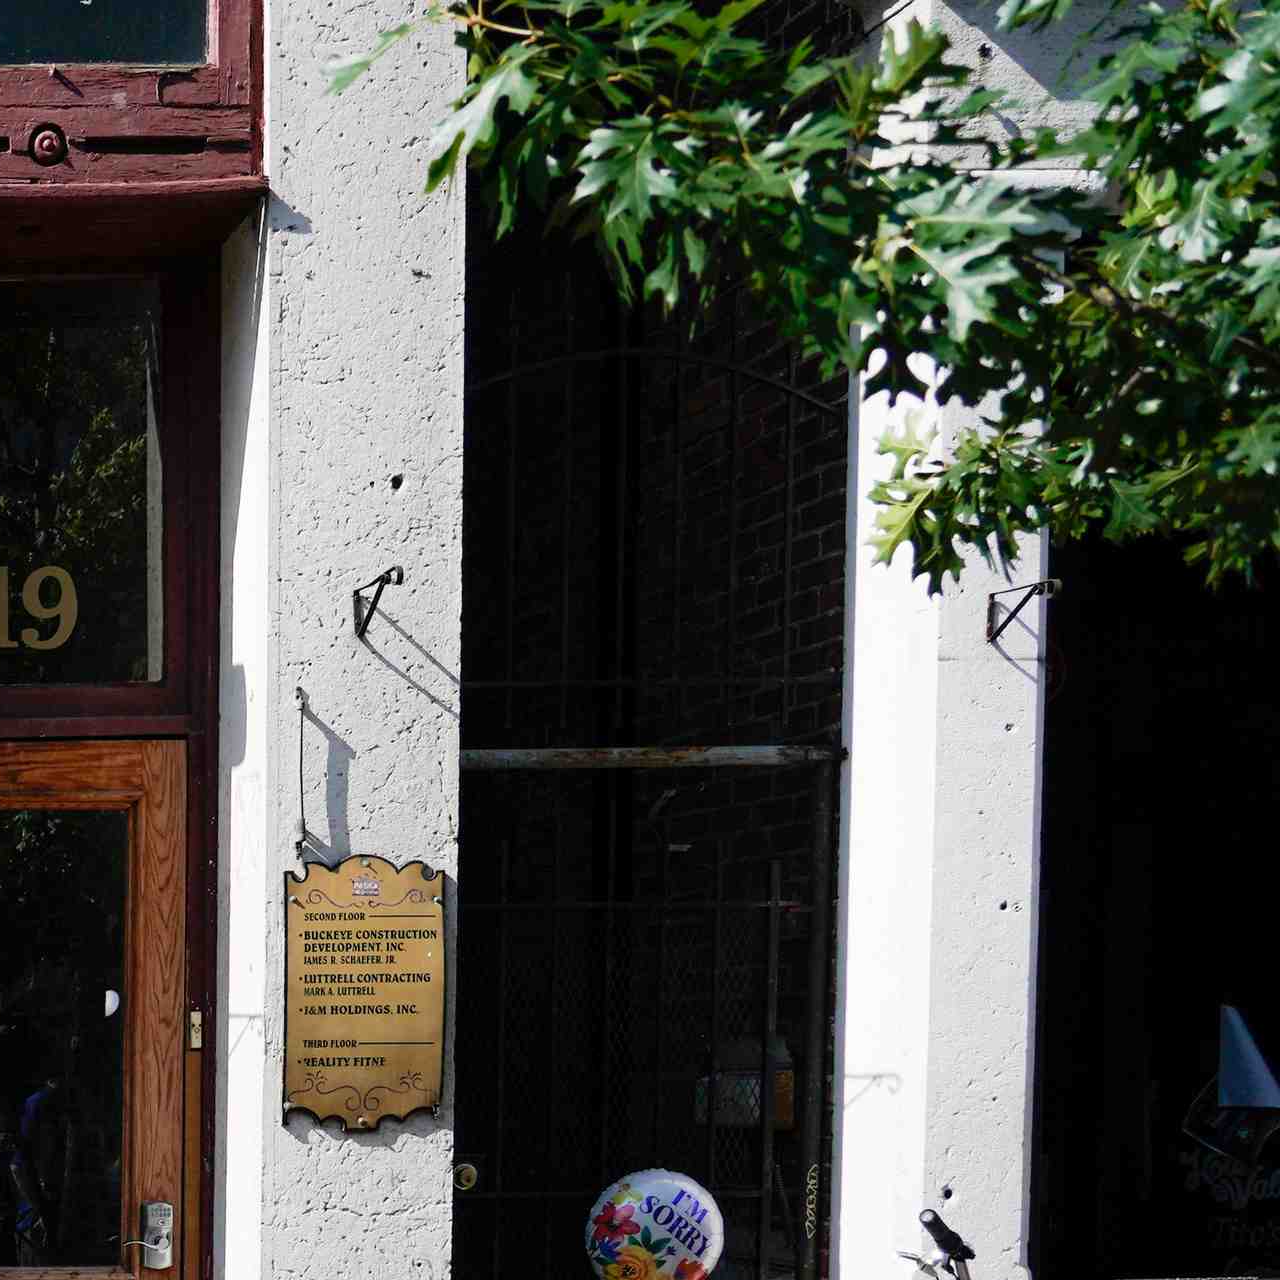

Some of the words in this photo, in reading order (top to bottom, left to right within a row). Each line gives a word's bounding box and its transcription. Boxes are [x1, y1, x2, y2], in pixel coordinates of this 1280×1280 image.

[304, 912, 337, 921] SECOND
[339, 912, 366, 921] FLOOR
[304, 930, 353, 940] BUCKEYE
[355, 929, 438, 940] CONSTRUCTION
[304, 955, 328, 965] JAMES
[304, 974, 355, 984] LUTTRELL
[357, 973, 431, 983] CONTRACTING
[304, 987, 326, 996] MARK
[337, 987, 376, 996] LUTTRELL
[303, 1039, 328, 1048] THIRD
[330, 1039, 357, 1048] FLOOR
[671, 1190, 708, 1224] I'M
[639, 1195, 712, 1257] SORRY
